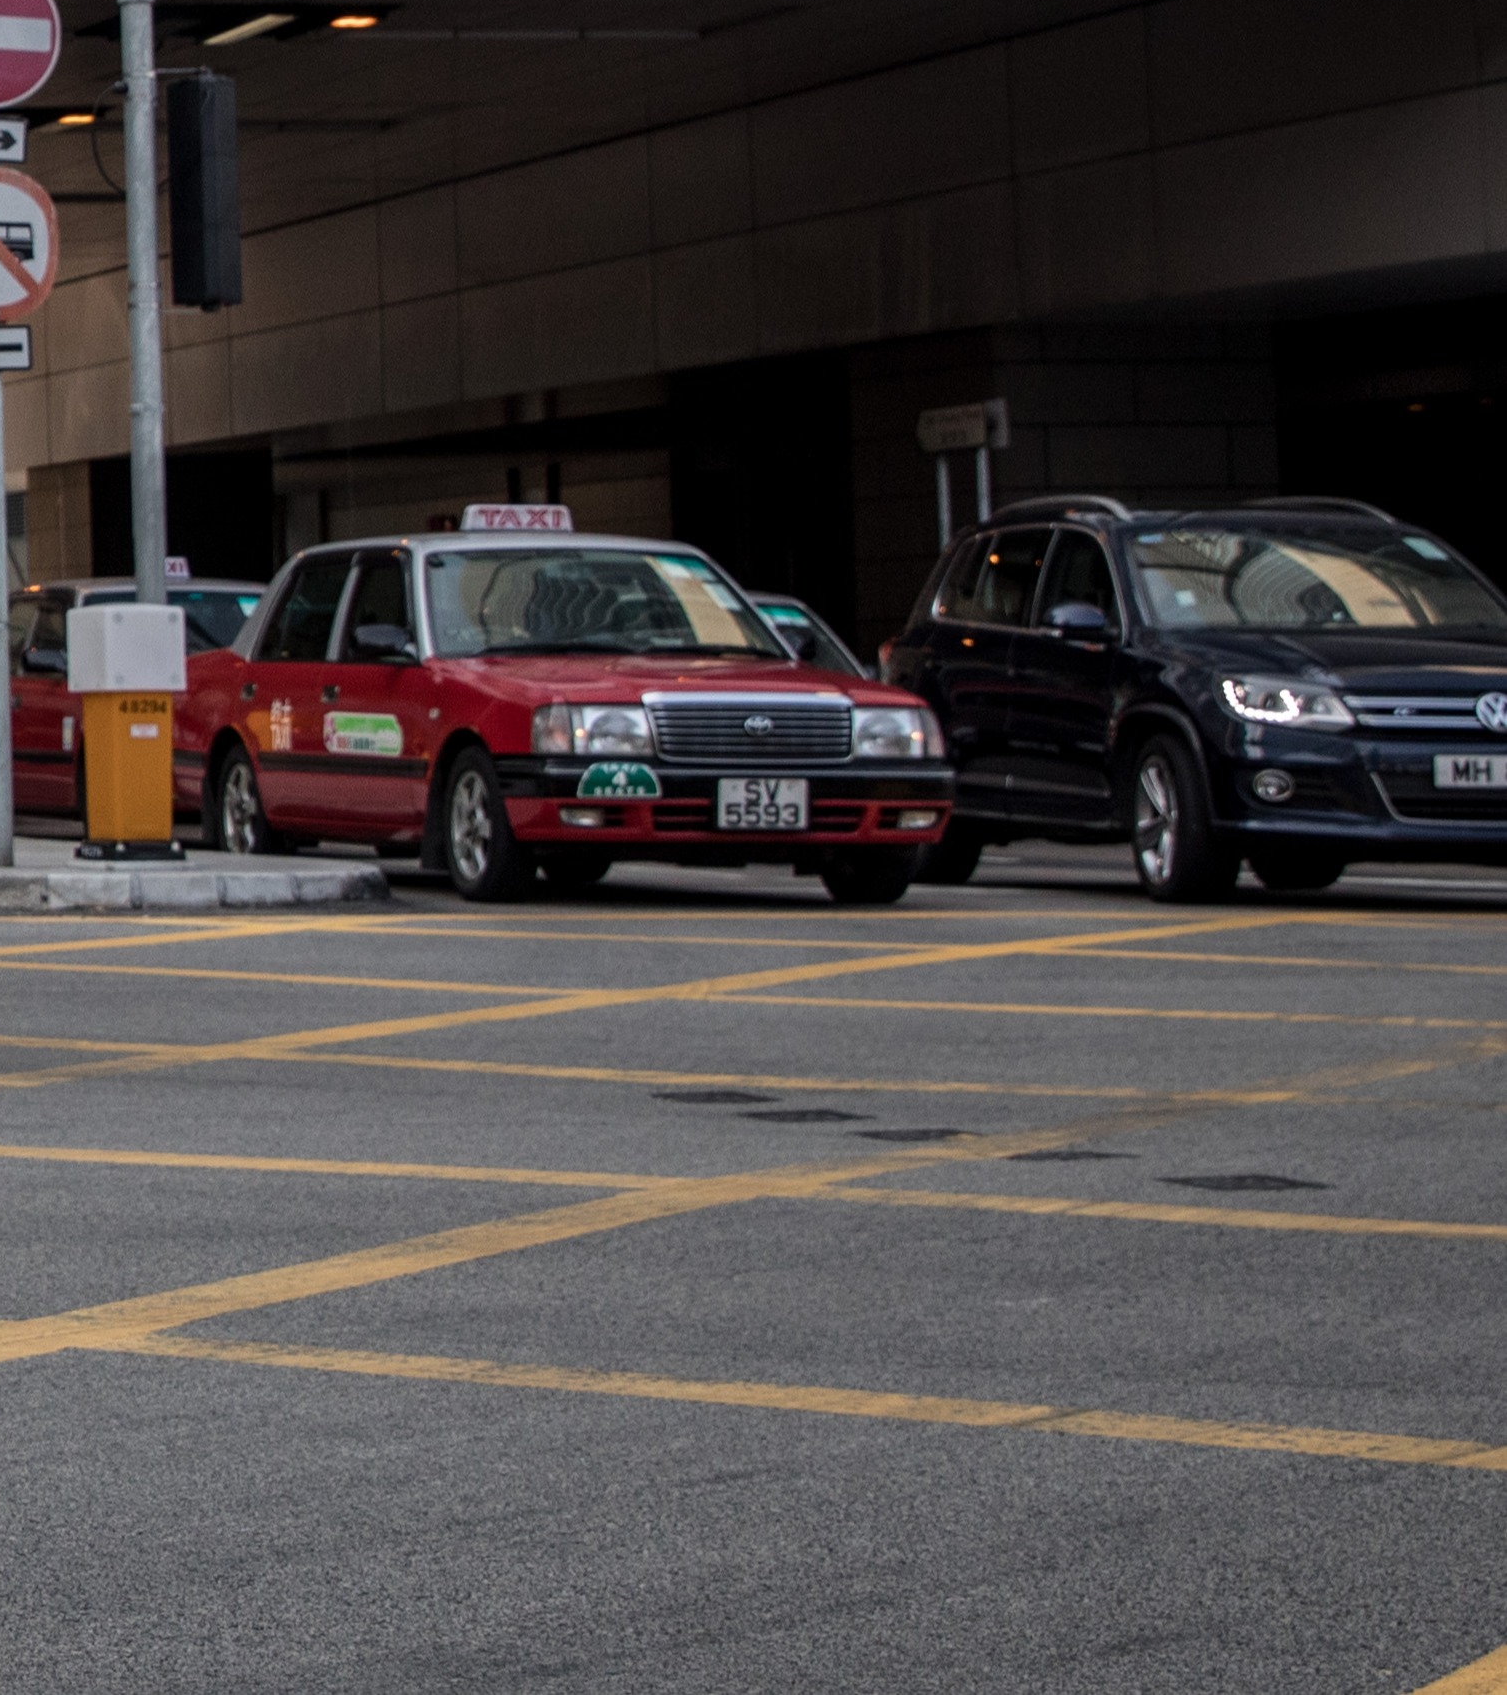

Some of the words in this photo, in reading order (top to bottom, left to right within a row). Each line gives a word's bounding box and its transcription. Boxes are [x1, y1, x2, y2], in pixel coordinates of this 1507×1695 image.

[477, 508, 563, 529] TAXI
[166, 560, 185, 575] XI
[611, 770, 627, 786] 4
[1451, 759, 1492, 783] MH
[744, 780, 781, 803] SV
[724, 803, 801, 826] 5593
